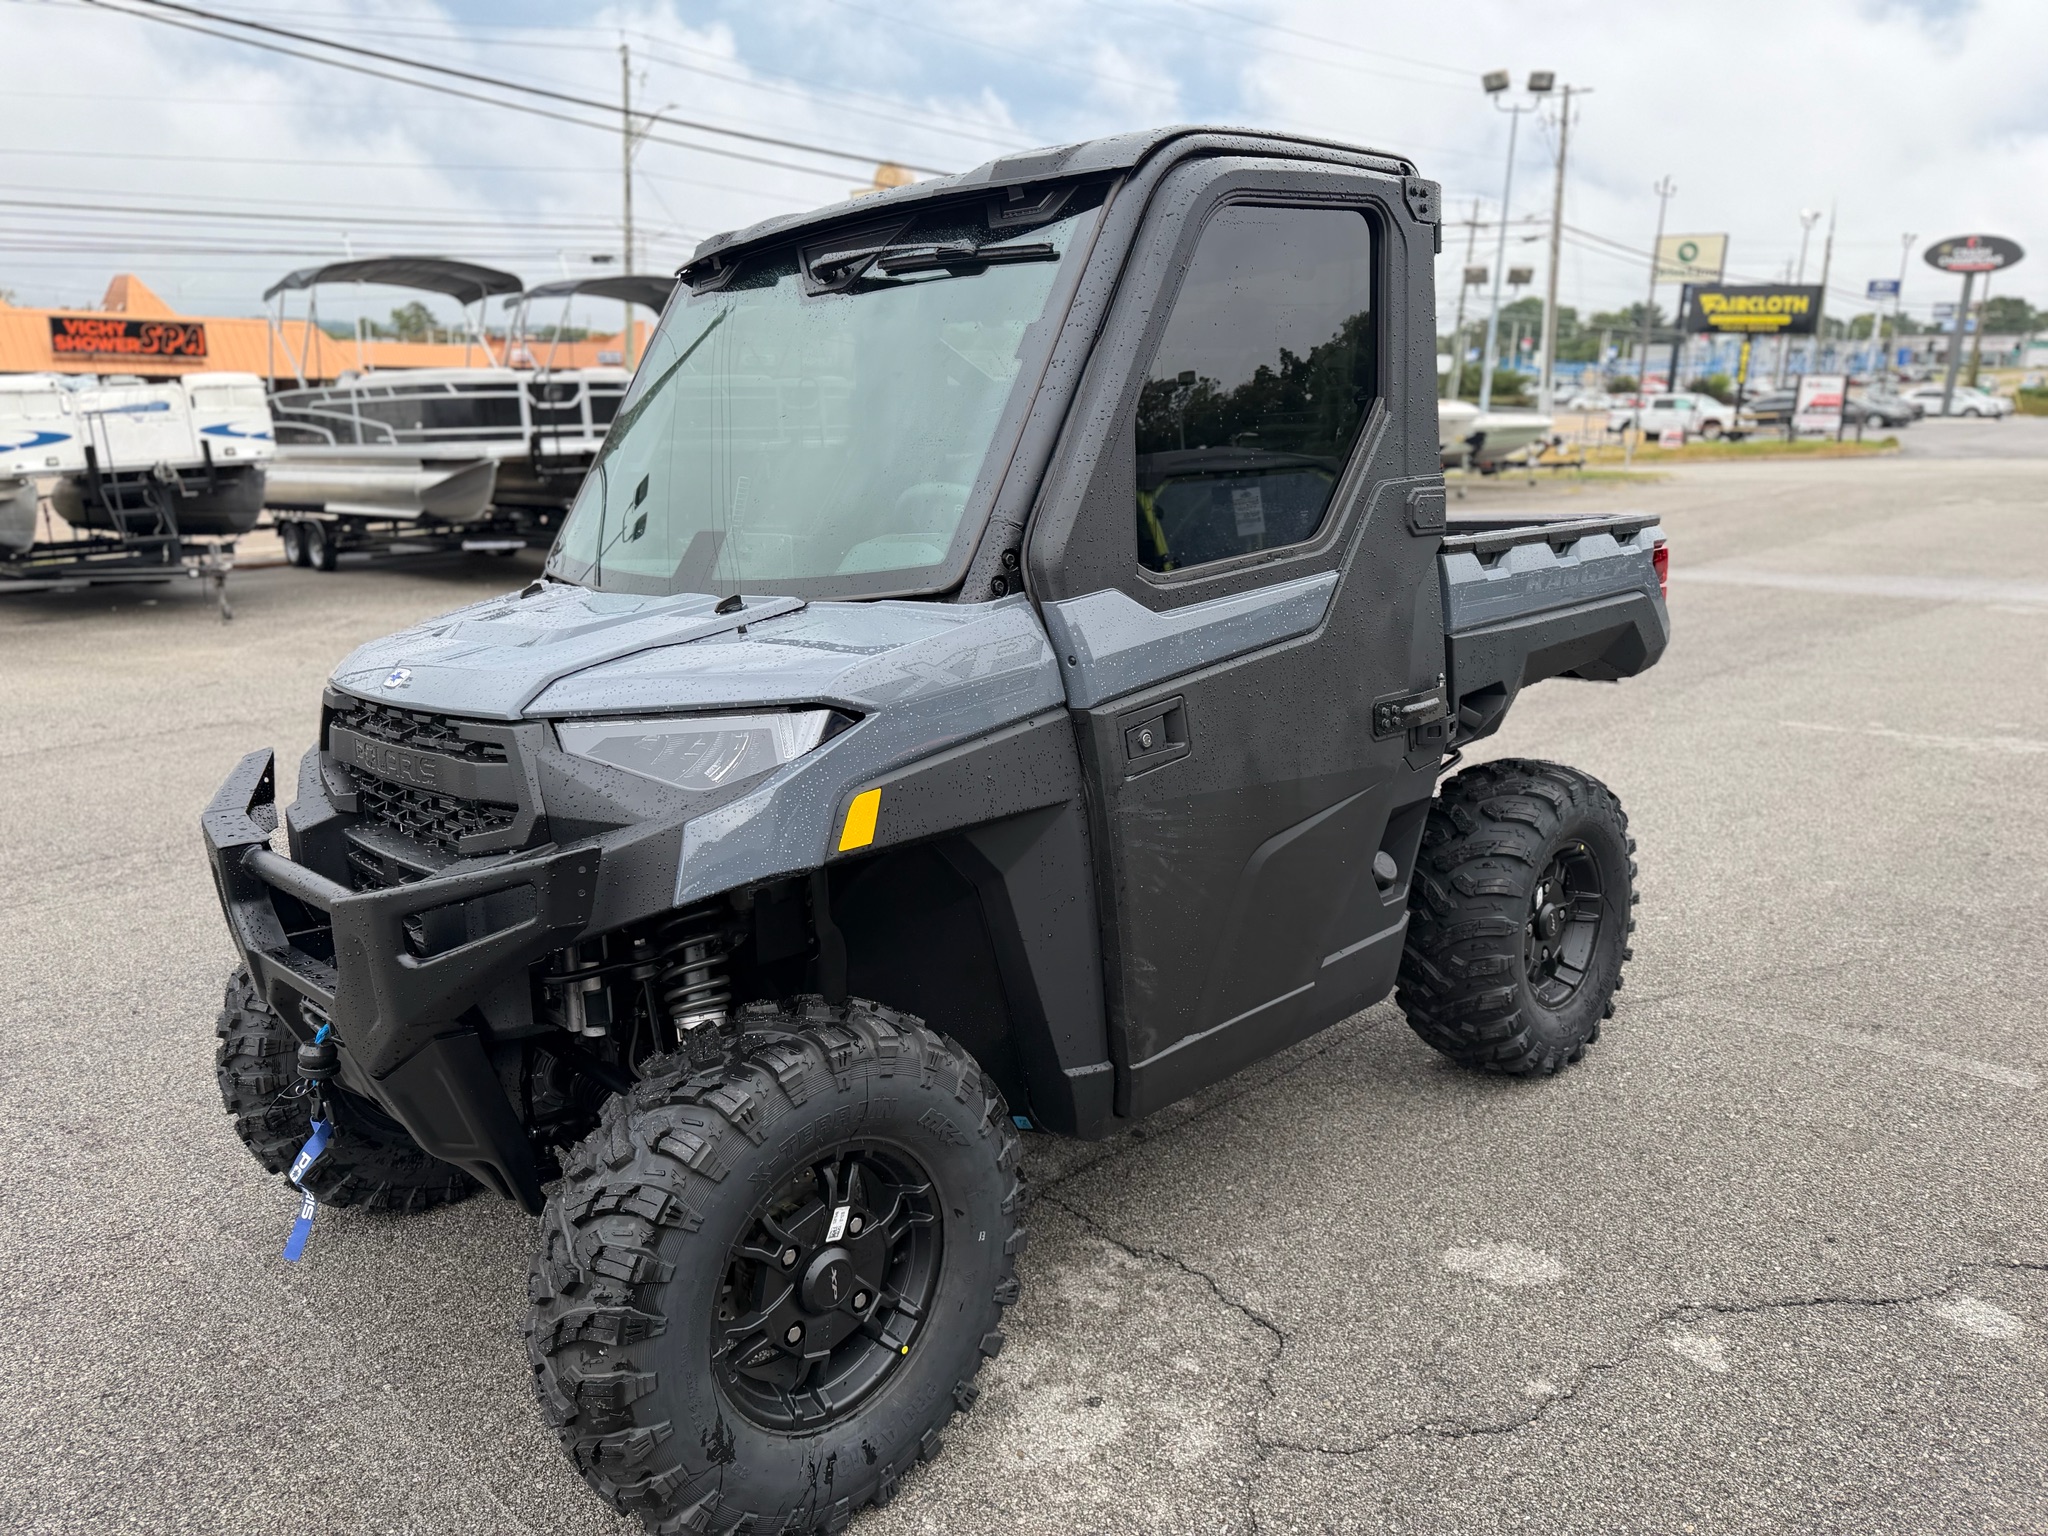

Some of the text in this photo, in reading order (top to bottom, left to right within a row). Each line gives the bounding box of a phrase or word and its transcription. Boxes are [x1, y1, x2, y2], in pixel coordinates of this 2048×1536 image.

[1700, 293, 1810, 314] FAIRCLOTH
[62, 319, 127, 337] VICHY
[54, 333, 141, 353] SHOWER
[140, 322, 206, 356] SPA
[355, 739, 436, 786] POLARIS
